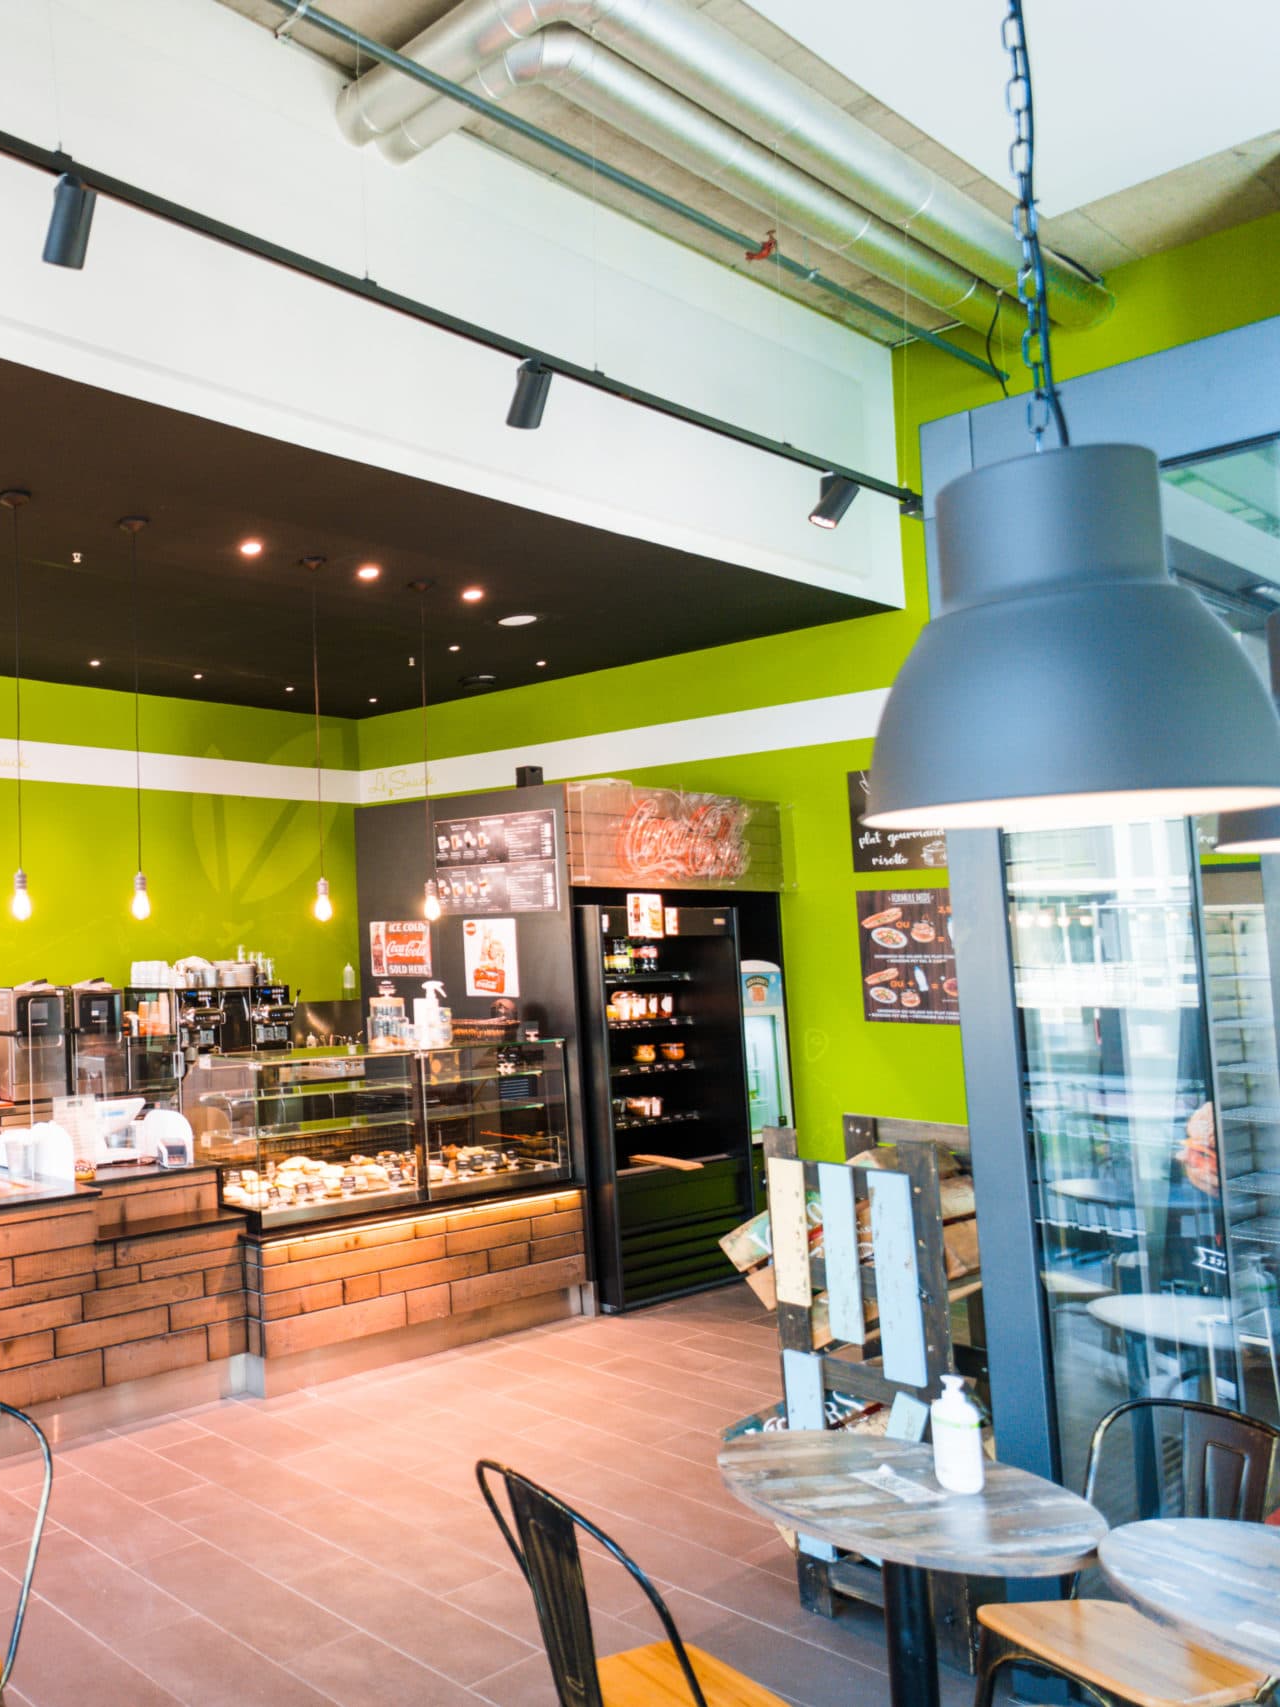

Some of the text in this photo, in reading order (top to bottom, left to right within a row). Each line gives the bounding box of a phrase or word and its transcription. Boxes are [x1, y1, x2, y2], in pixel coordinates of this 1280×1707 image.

[858, 831, 881, 850] plat
[871, 852, 909, 866] risotto
[390, 922, 426, 932] ICE COLD
[389, 965, 408, 975] SOLD
